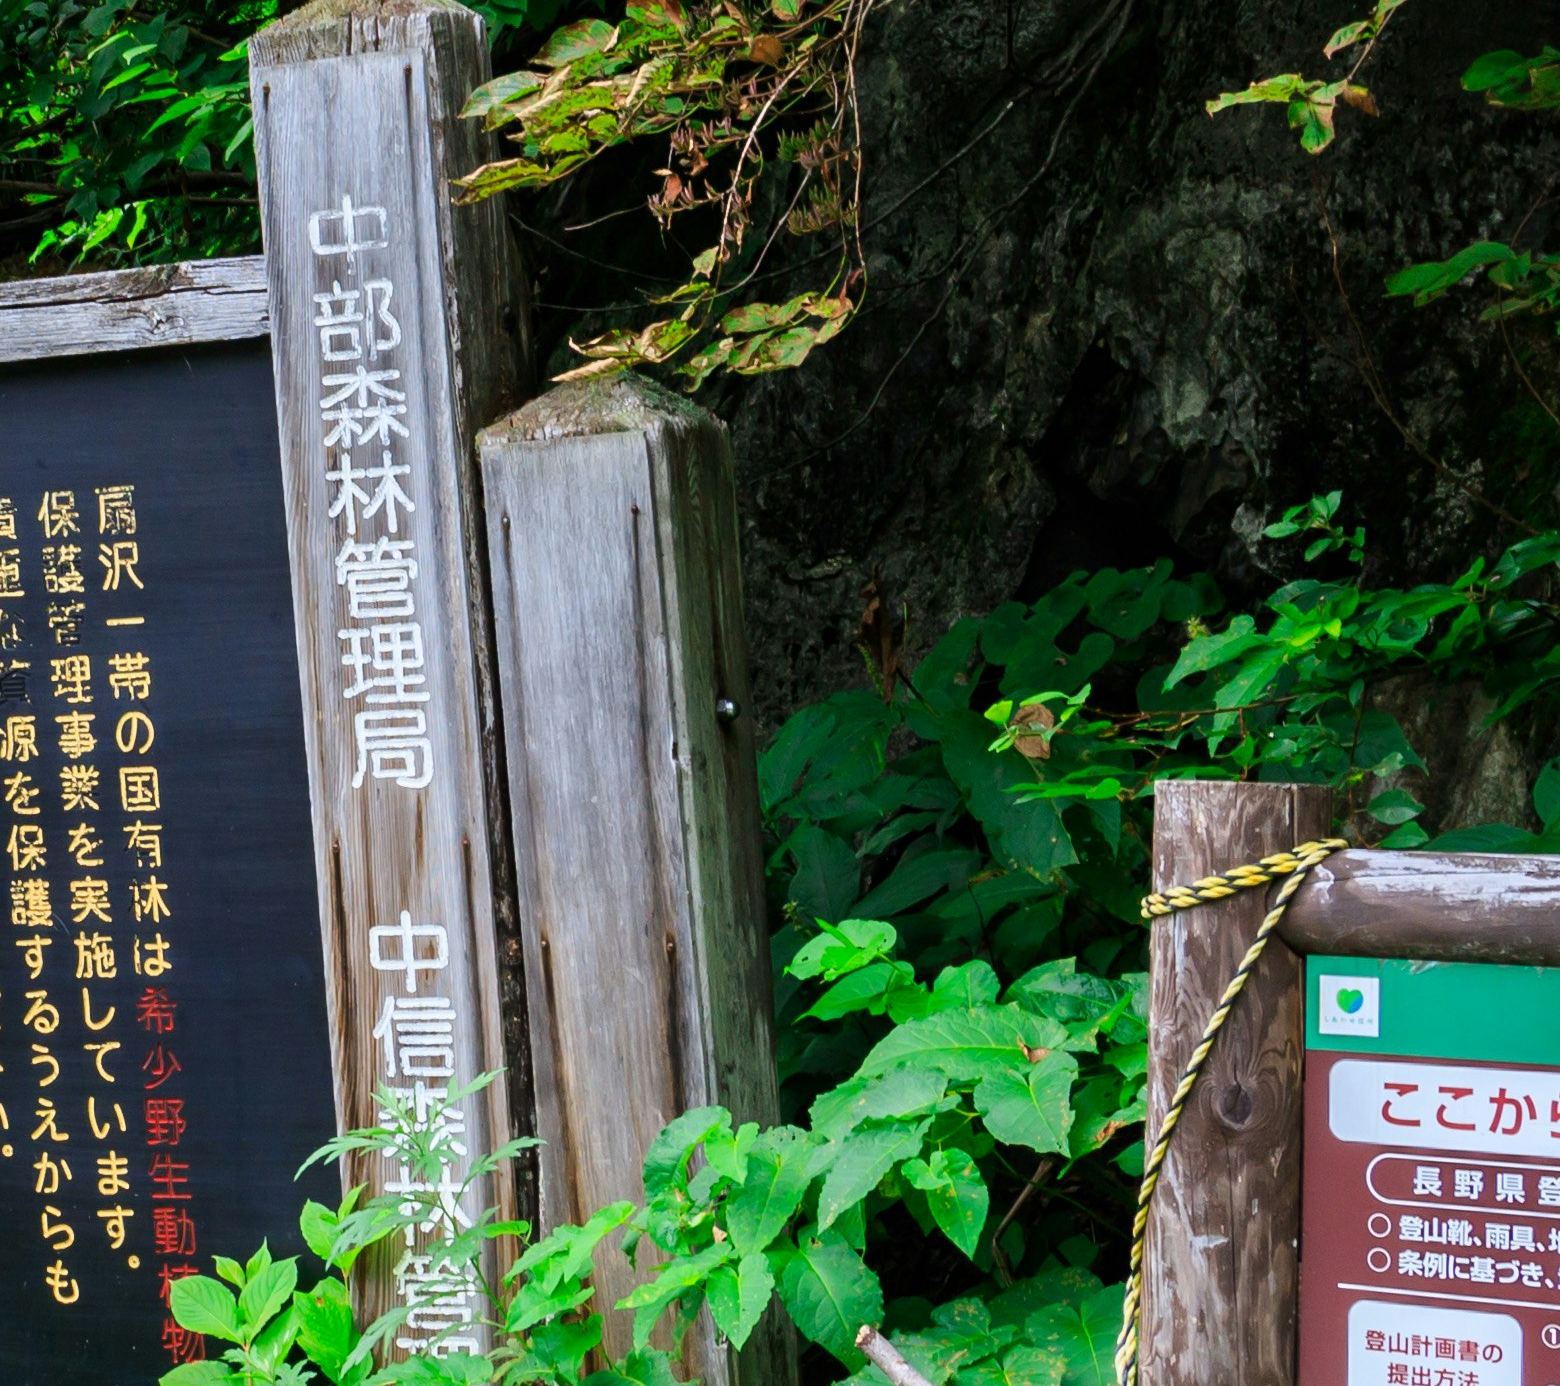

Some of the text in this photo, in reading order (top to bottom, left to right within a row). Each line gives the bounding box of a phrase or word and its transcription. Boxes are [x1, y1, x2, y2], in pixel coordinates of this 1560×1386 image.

[308, 195, 433, 788] 中部森林管理局
[38, 490, 139, 1269] 保護管理事業を実施しています。
[1364, 1331, 1503, 1365] 登山計画書の
